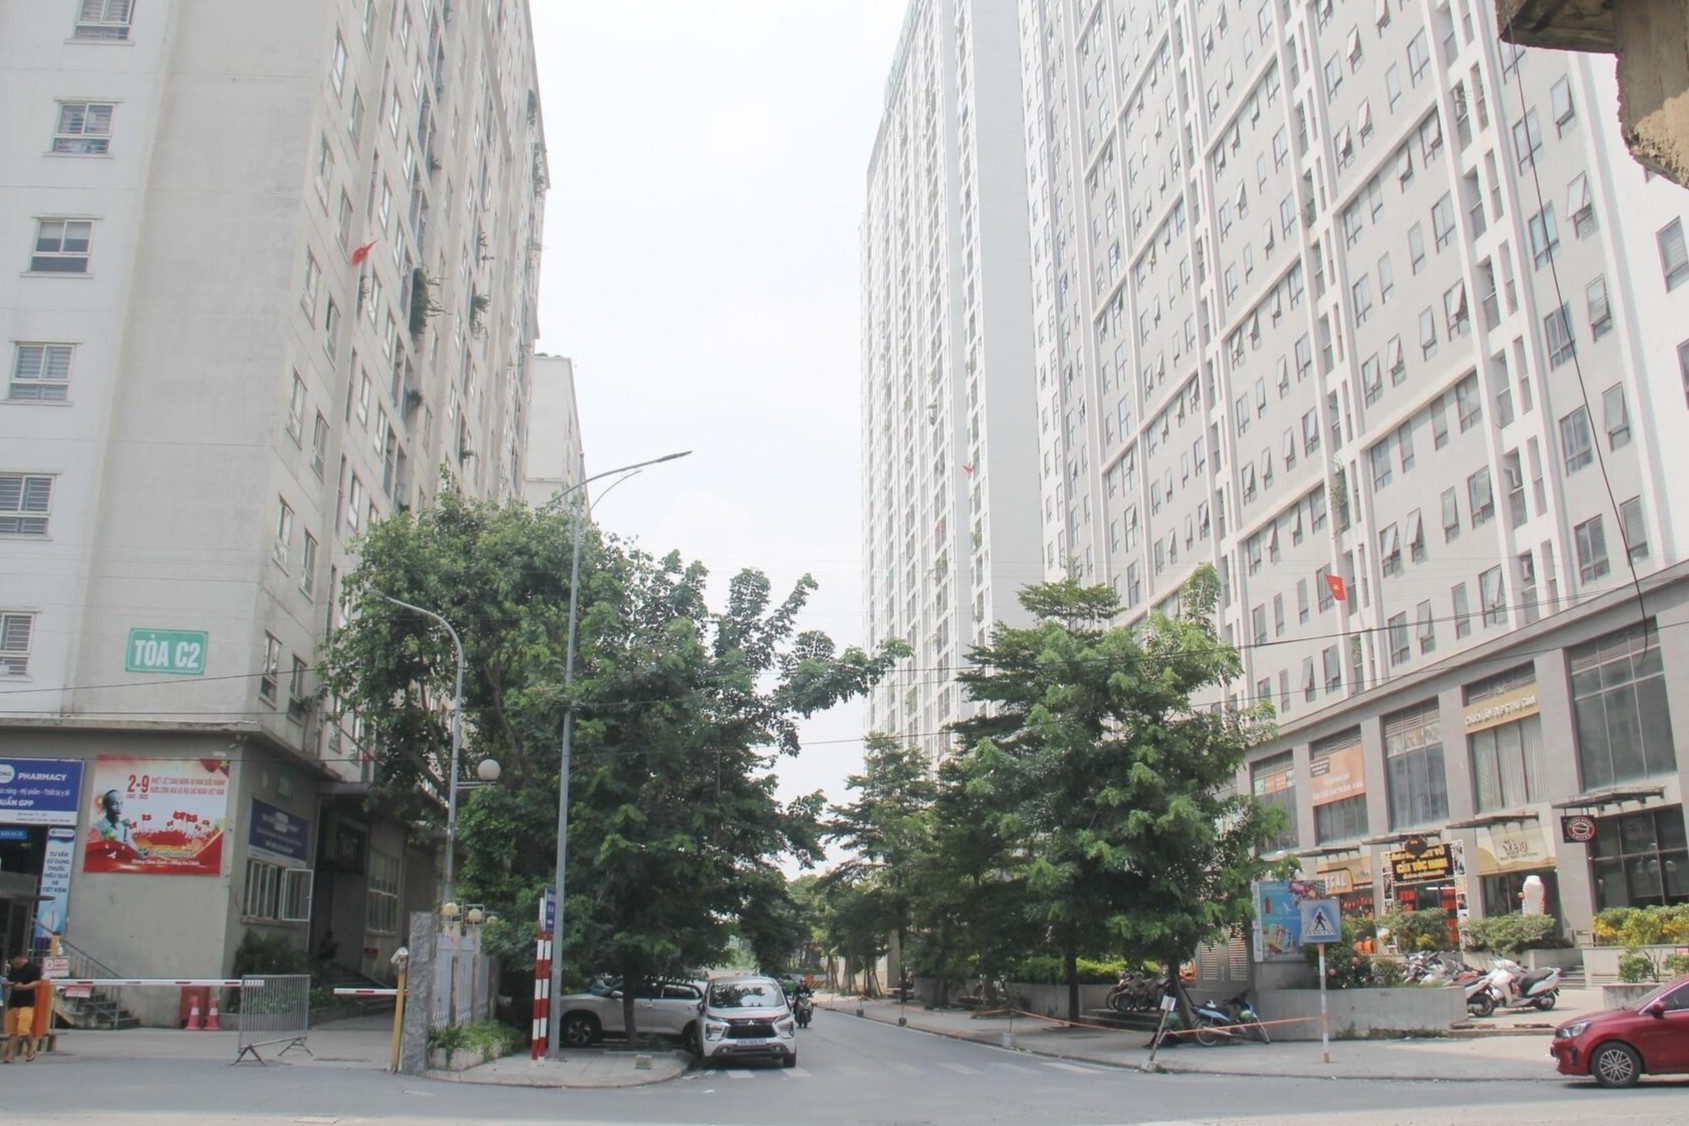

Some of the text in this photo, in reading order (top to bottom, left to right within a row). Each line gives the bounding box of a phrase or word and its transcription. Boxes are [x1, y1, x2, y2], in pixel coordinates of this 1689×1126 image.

[134, 634, 201, 668] TÒA C2
[18, 772, 67, 781] PHARMACY
[127, 774, 149, 793] 2-9
